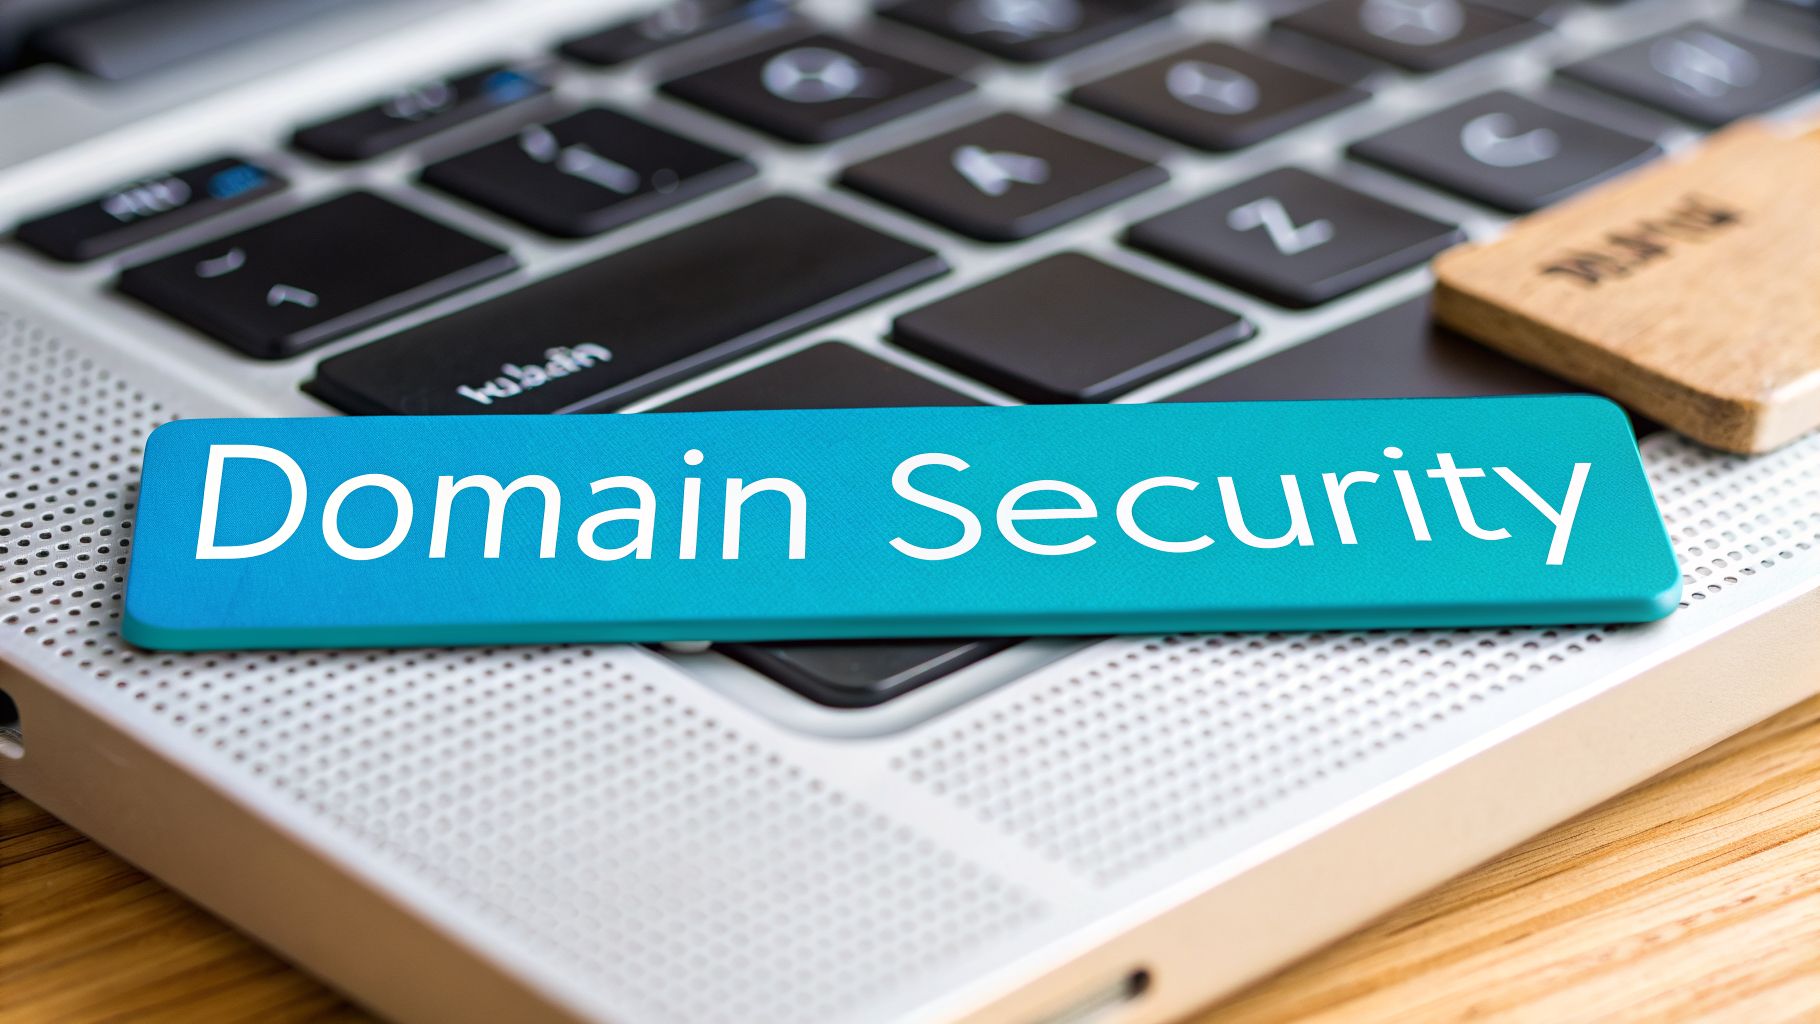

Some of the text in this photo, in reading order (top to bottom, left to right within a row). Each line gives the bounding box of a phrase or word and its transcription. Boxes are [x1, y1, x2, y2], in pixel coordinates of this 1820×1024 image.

[1227, 197, 1334, 255] Z
[195, 444, 1591, 565] Domain Security
